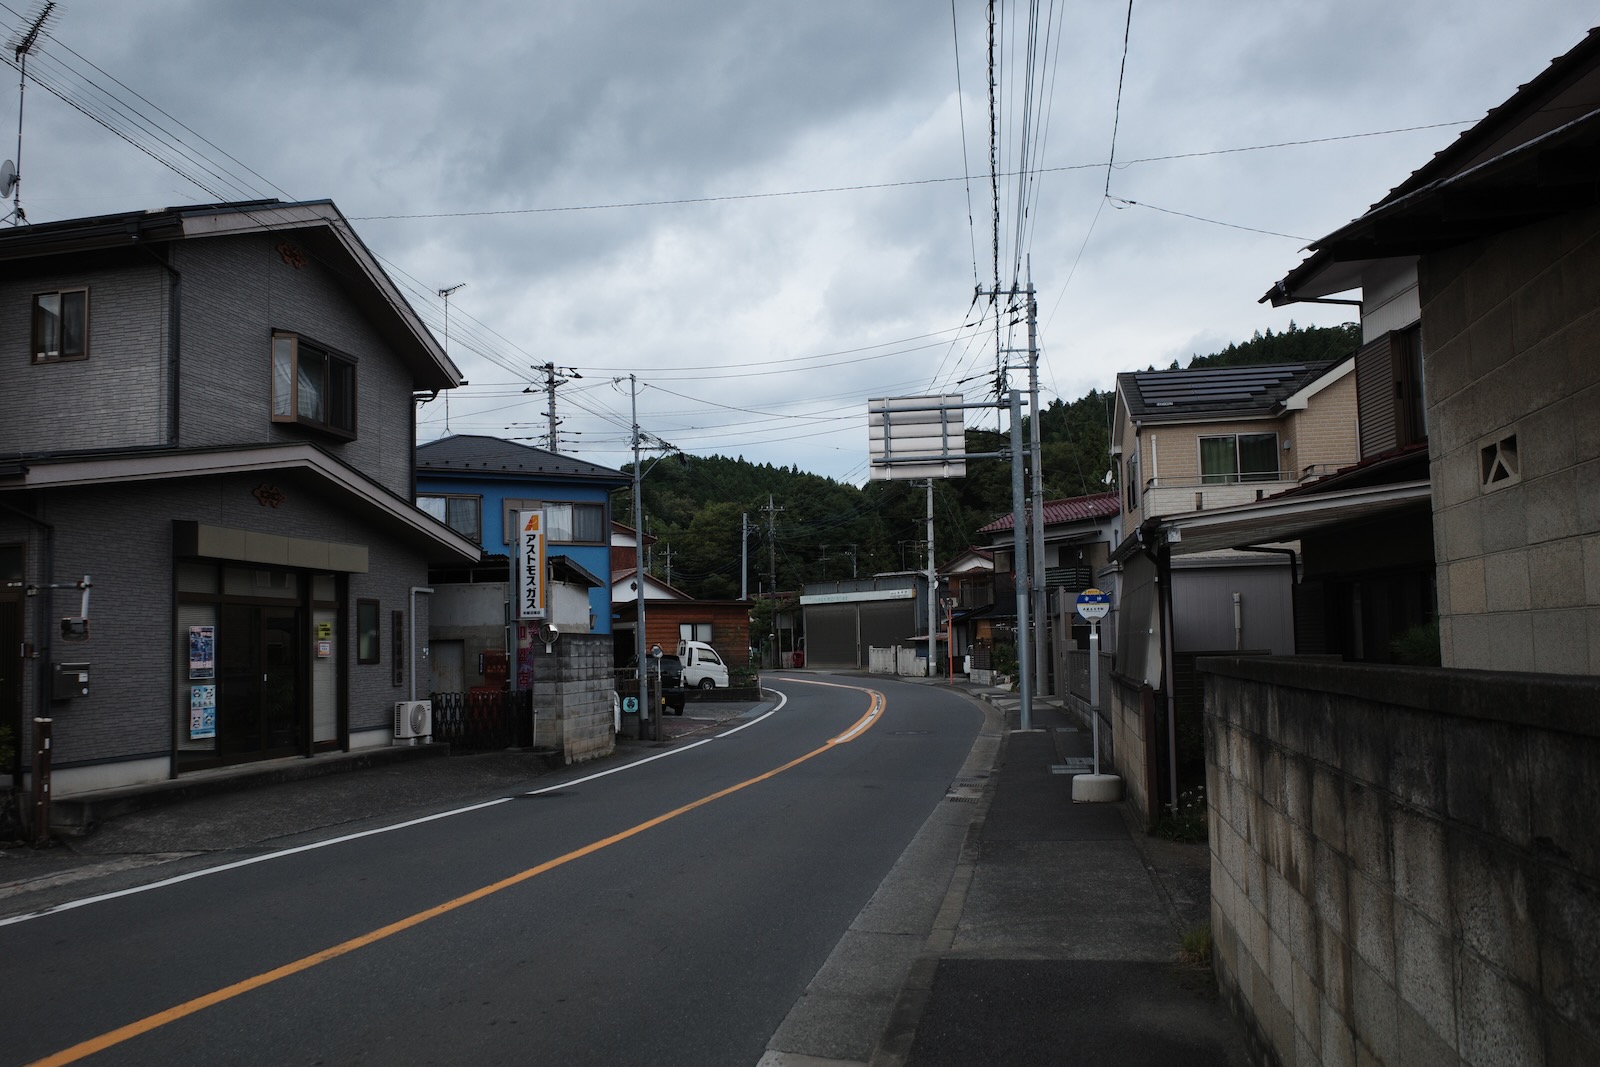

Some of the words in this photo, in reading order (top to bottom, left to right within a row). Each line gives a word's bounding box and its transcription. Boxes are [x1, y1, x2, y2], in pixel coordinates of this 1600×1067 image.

[526, 534, 537, 608] アストモスガス
